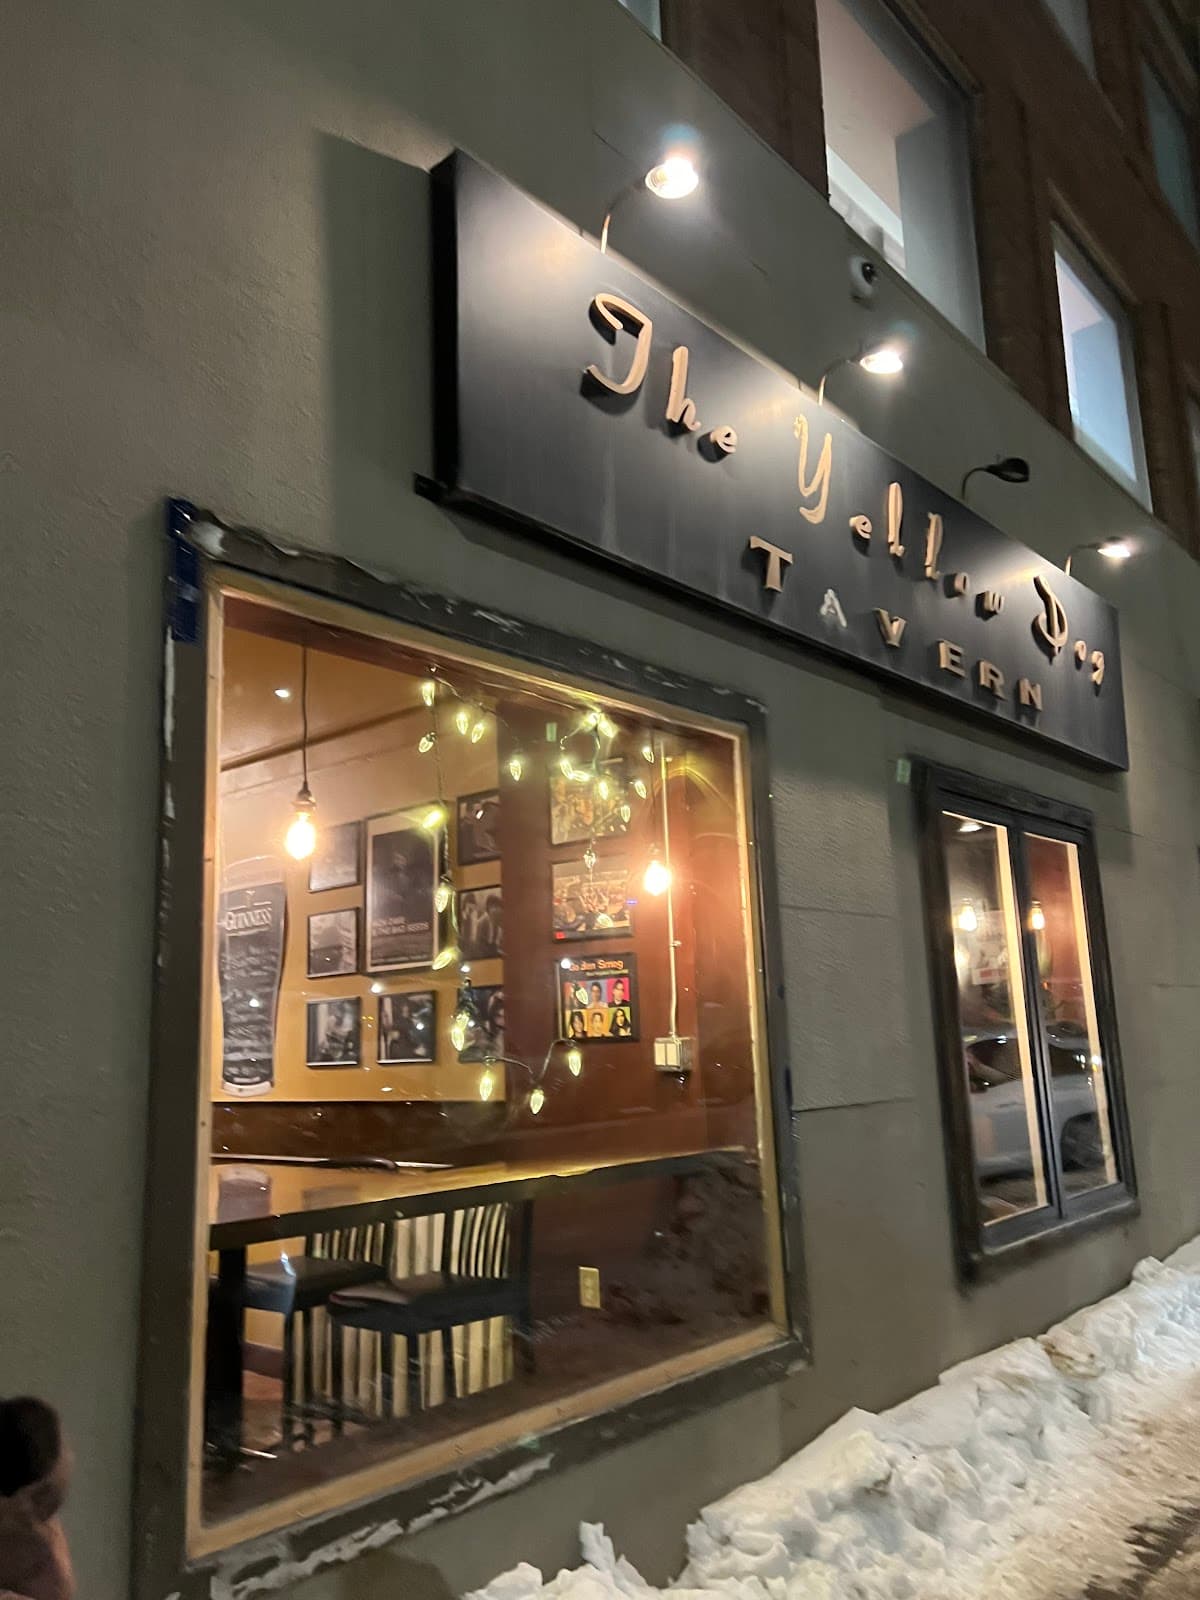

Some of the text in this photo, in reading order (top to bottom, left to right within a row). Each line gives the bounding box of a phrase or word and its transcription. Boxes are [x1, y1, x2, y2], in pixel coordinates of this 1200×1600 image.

[583, 292, 1106, 686] The Yellow Dog
[749, 535, 1043, 712] TAVERN
